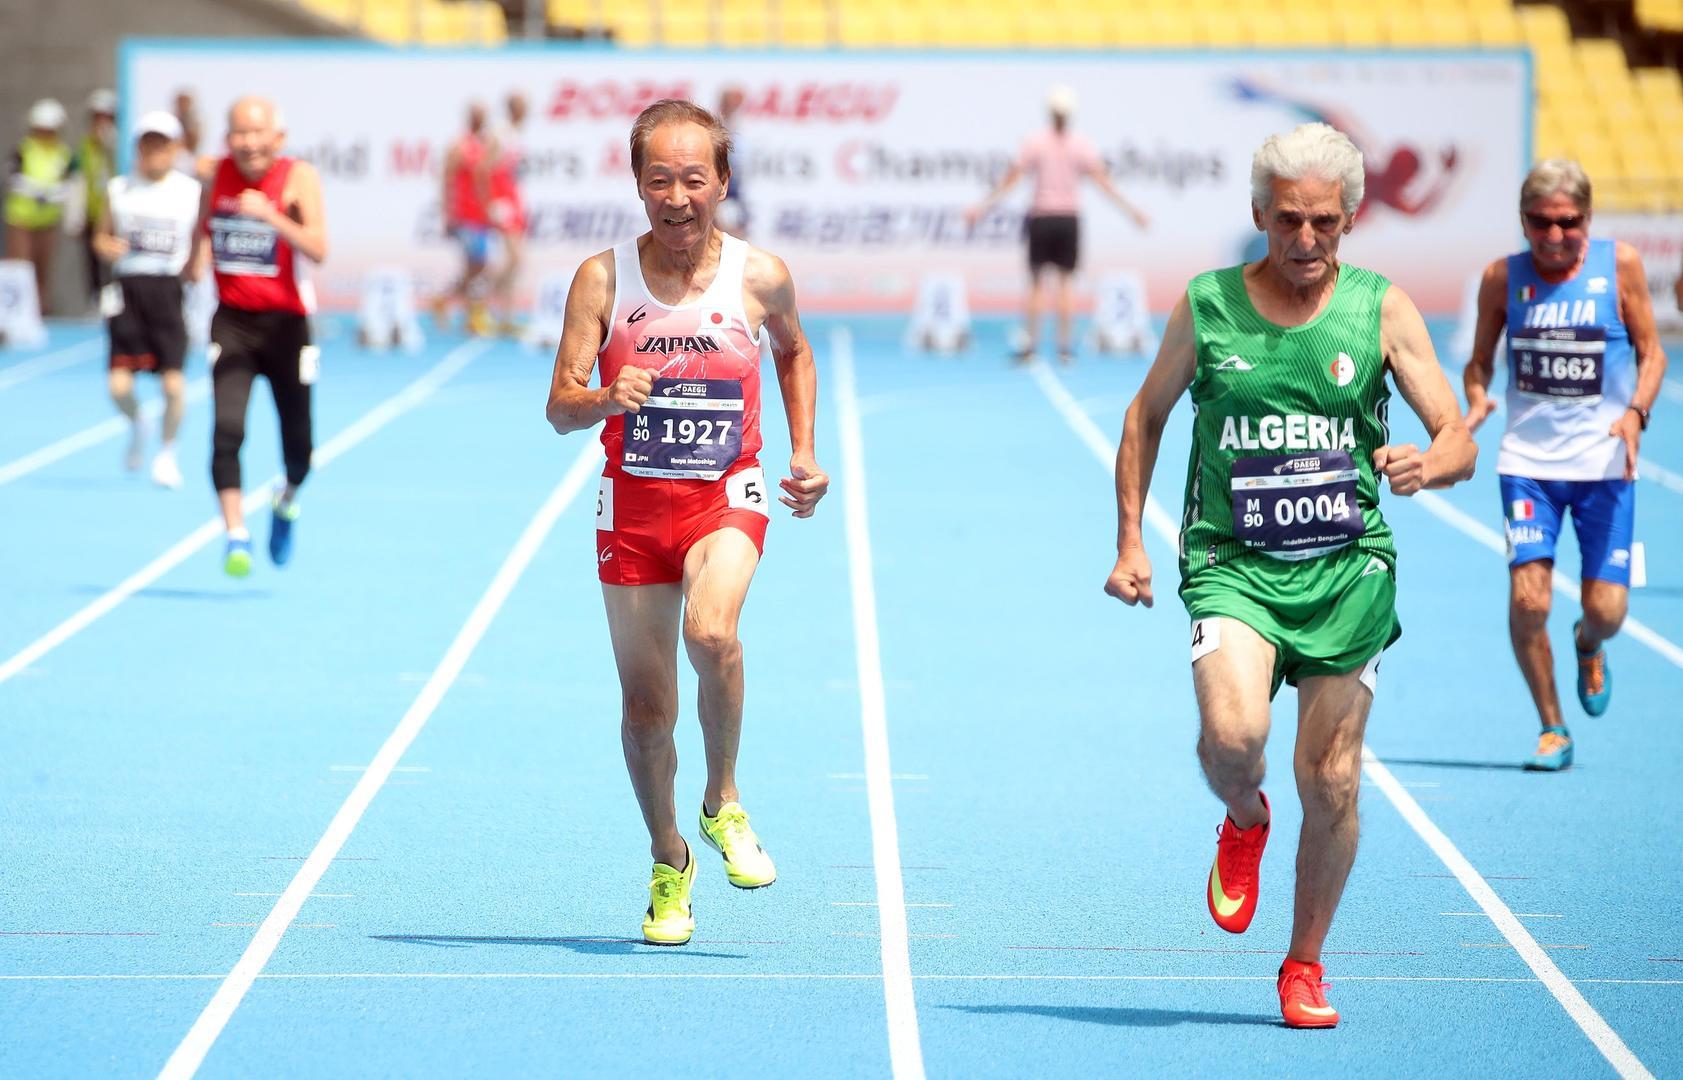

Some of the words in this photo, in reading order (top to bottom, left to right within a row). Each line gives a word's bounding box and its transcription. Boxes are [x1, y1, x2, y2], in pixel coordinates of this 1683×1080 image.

[737, 82, 898, 119] AEGU
[1524, 299, 1596, 328] ITALIA
[634, 335, 723, 358] JAPAN
[1539, 355, 1597, 381] 1662
[636, 414, 648, 427] M
[661, 418, 733, 446] 1927
[1219, 414, 1356, 451] ALGERIA
[632, 427, 650, 441] 90
[1293, 458, 1321, 469] DAEGU
[744, 482, 762, 504] 5
[1246, 498, 1260, 512] M
[1243, 513, 1264, 528] 90
[1275, 491, 1350, 526] 0004
[1192, 622, 1205, 648] 4
